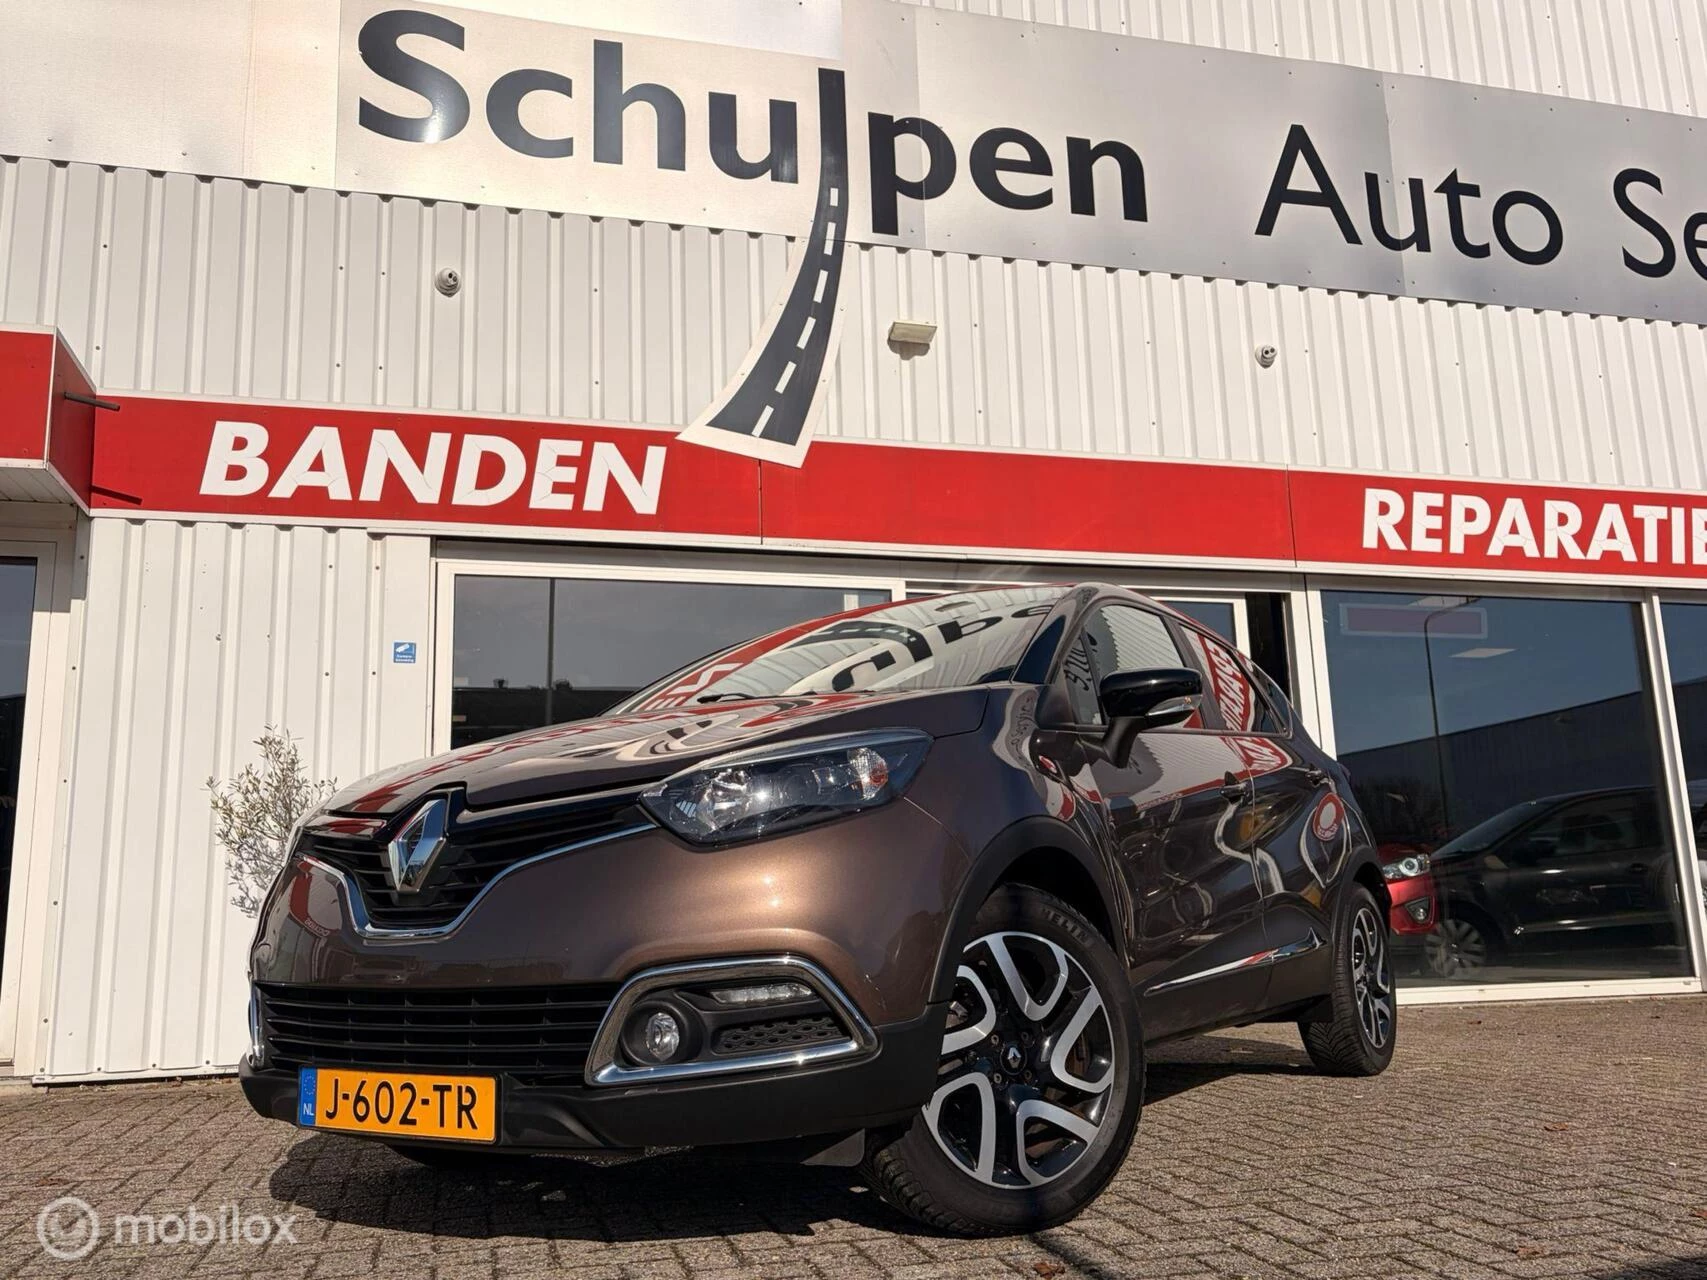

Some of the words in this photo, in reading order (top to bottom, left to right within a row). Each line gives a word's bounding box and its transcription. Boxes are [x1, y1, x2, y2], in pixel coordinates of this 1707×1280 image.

[1255, 124, 1564, 266] Auto
[199, 420, 667, 515] BANDEN
[303, 1103, 315, 1116] NL
[325, 1078, 478, 1130] J-602-TR
